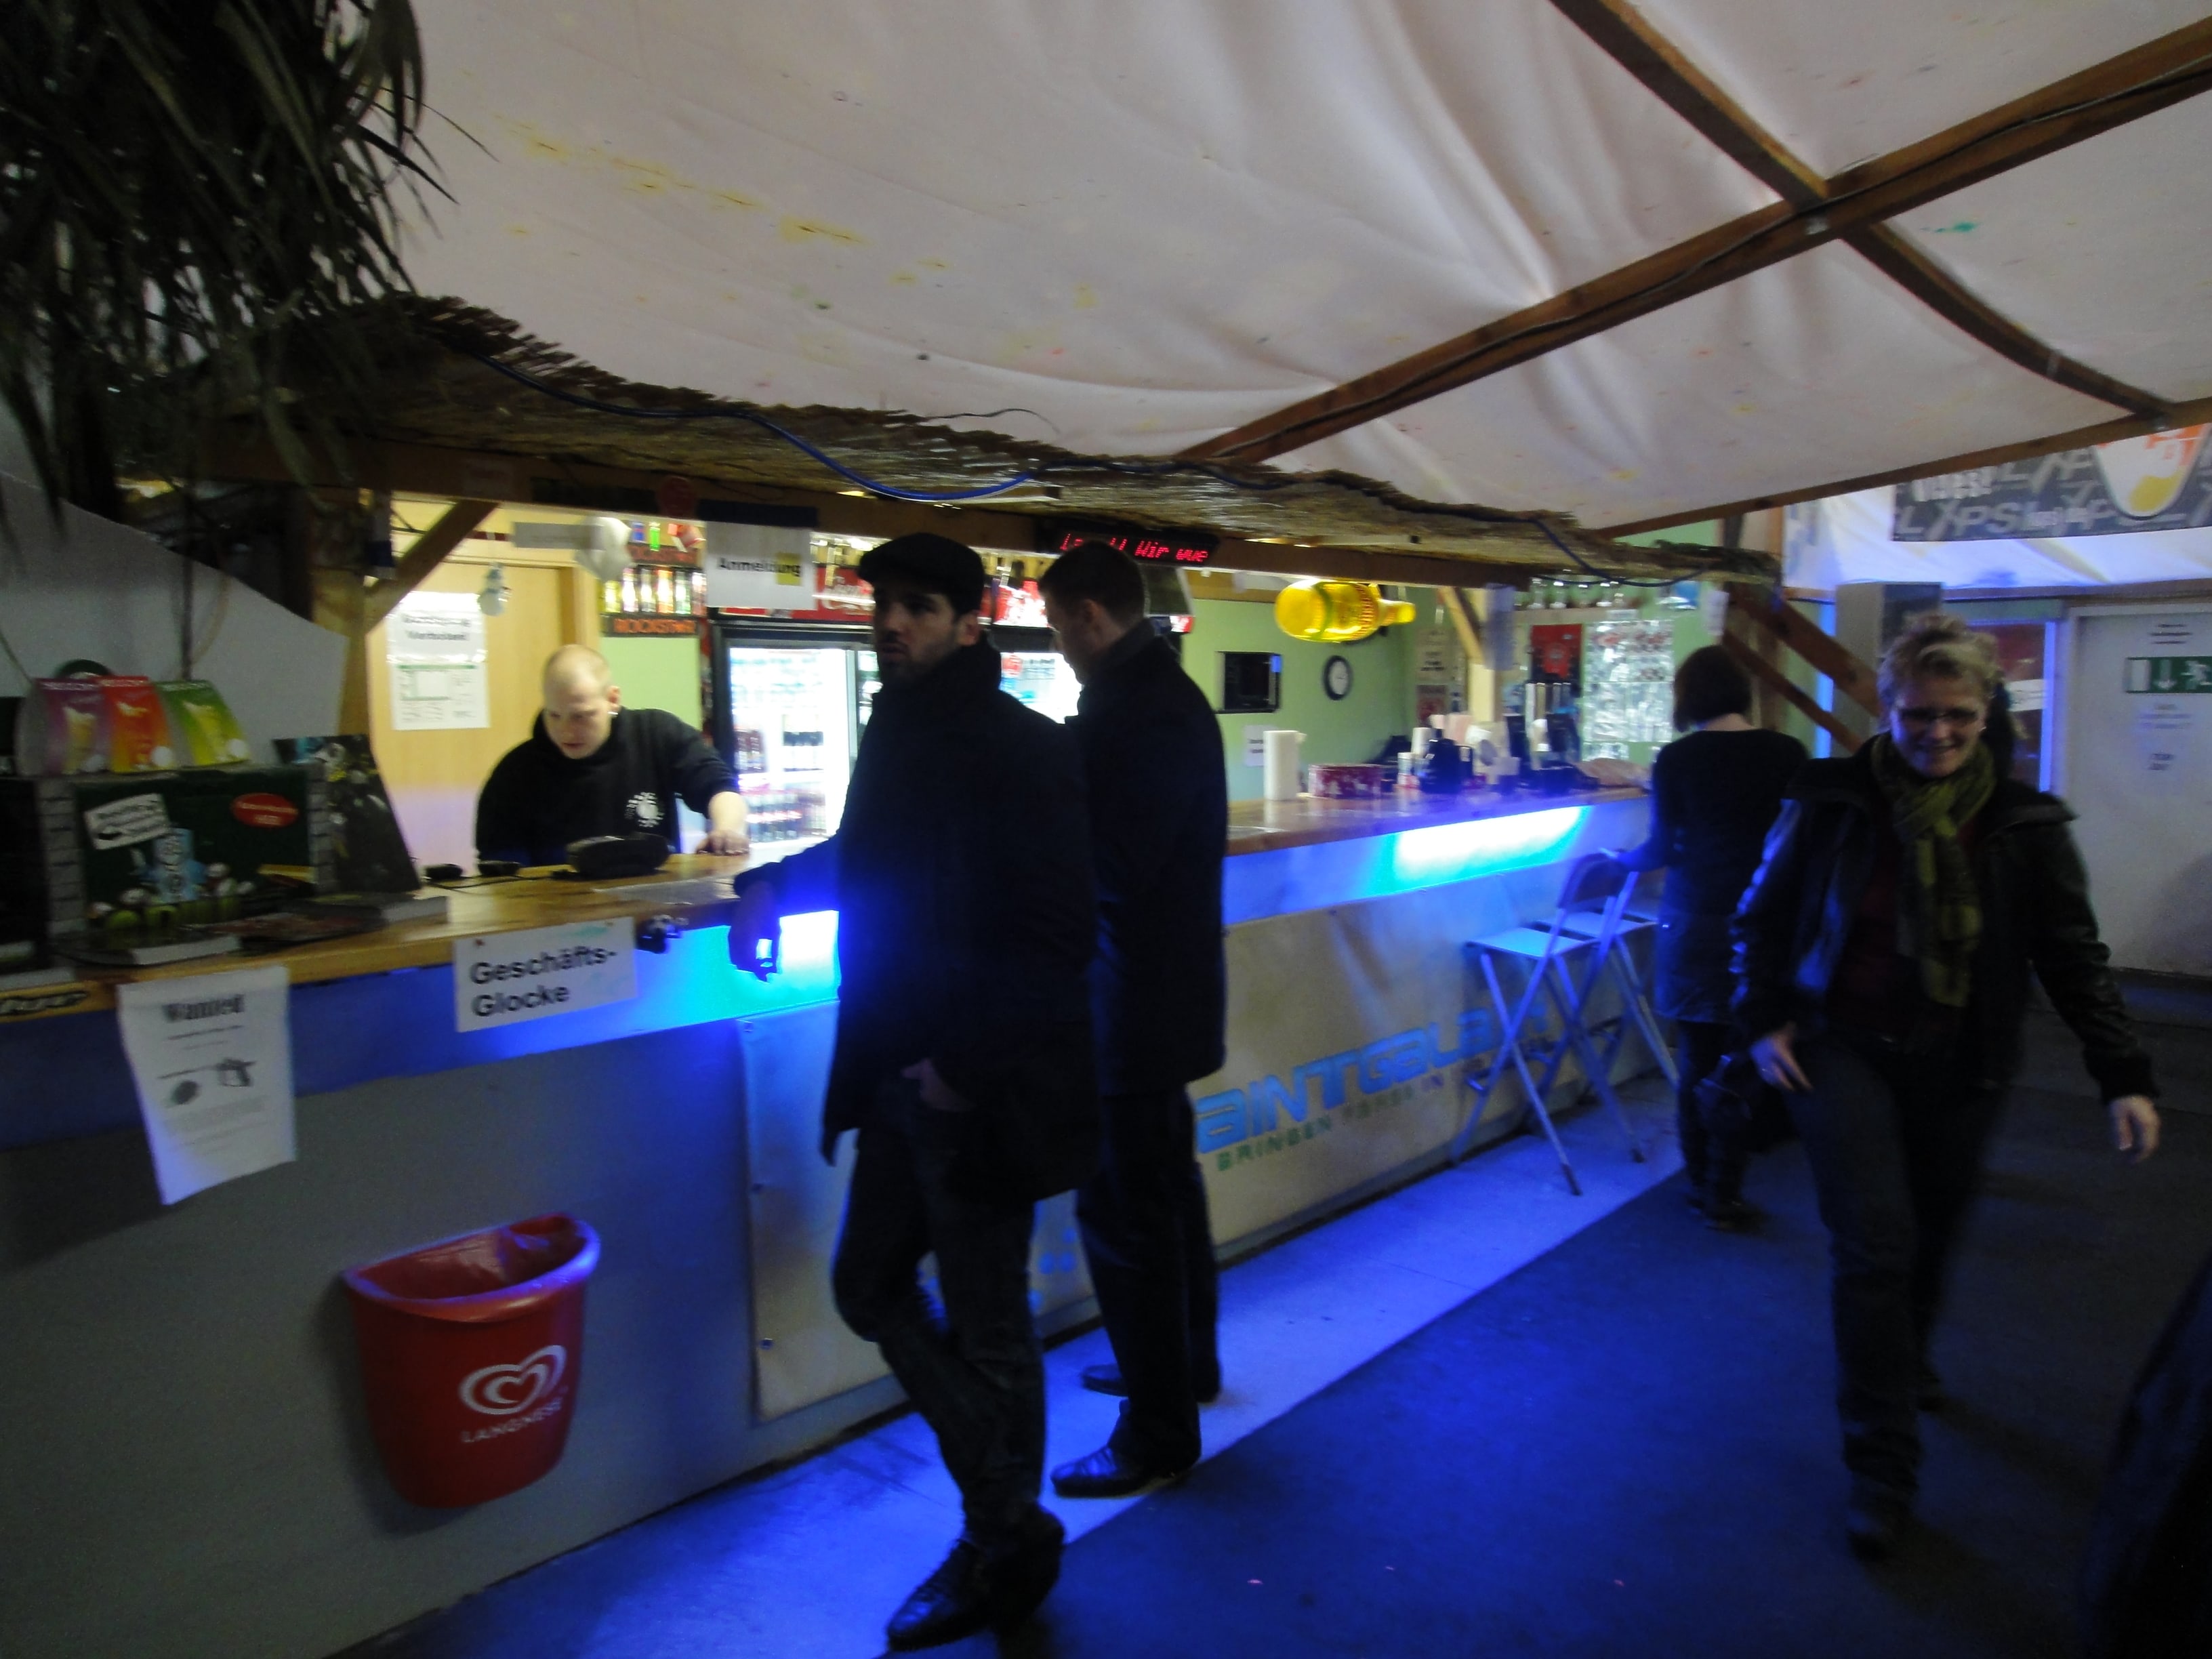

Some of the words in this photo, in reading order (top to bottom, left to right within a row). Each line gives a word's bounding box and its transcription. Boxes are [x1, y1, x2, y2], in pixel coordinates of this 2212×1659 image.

[1134, 540, 1170, 558] Wir
[718, 557, 802, 577] Anmeldung
[471, 945, 617, 984] Geschäfts-
[472, 985, 569, 1017] Glocke
